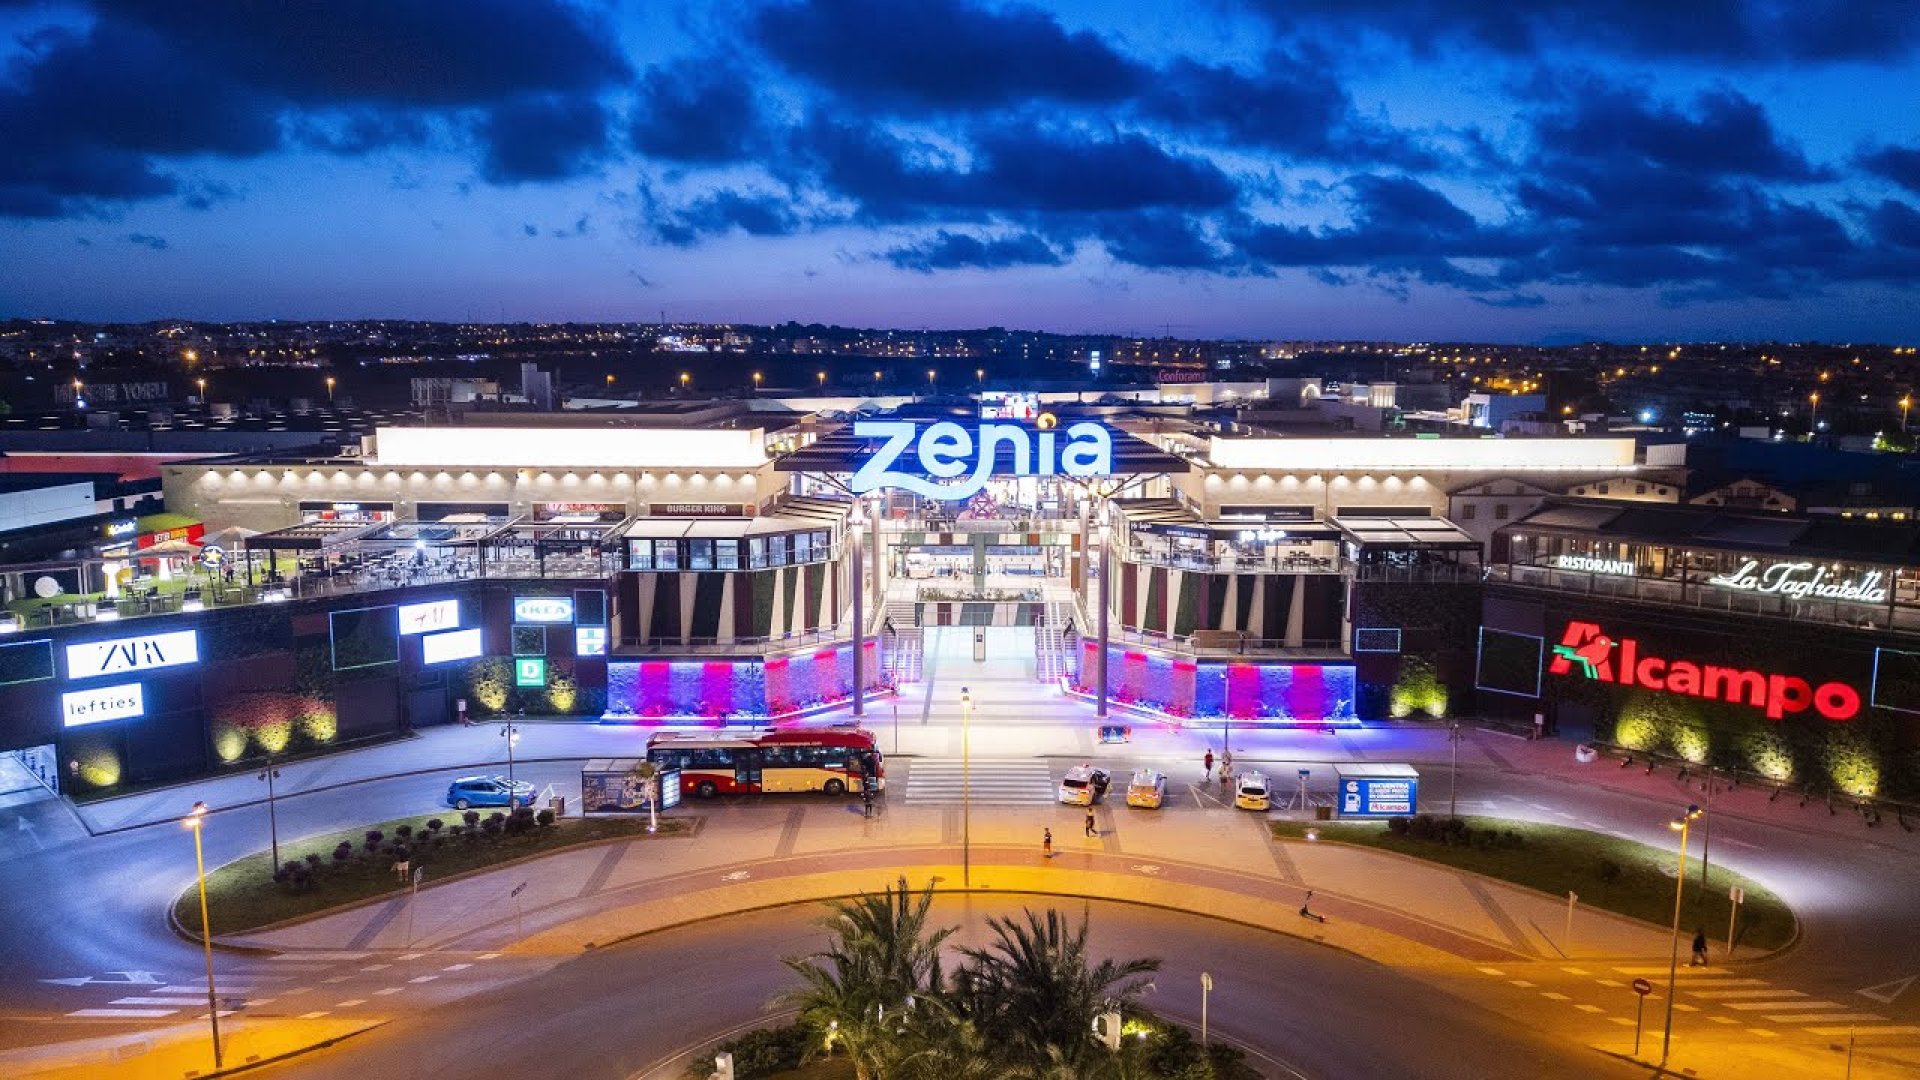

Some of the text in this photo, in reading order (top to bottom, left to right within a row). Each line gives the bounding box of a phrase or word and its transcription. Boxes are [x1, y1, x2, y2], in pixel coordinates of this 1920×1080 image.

[667, 505, 727, 513] BURGER KING
[1559, 555, 1633, 576] RISTORANTI
[1711, 560, 1886, 601] La Tagliatella
[521, 605, 566, 614] IKEA
[1550, 621, 1860, 718] Alcampo
[69, 697, 136, 715] lefties
[1372, 802, 1408, 812] Alcampo
